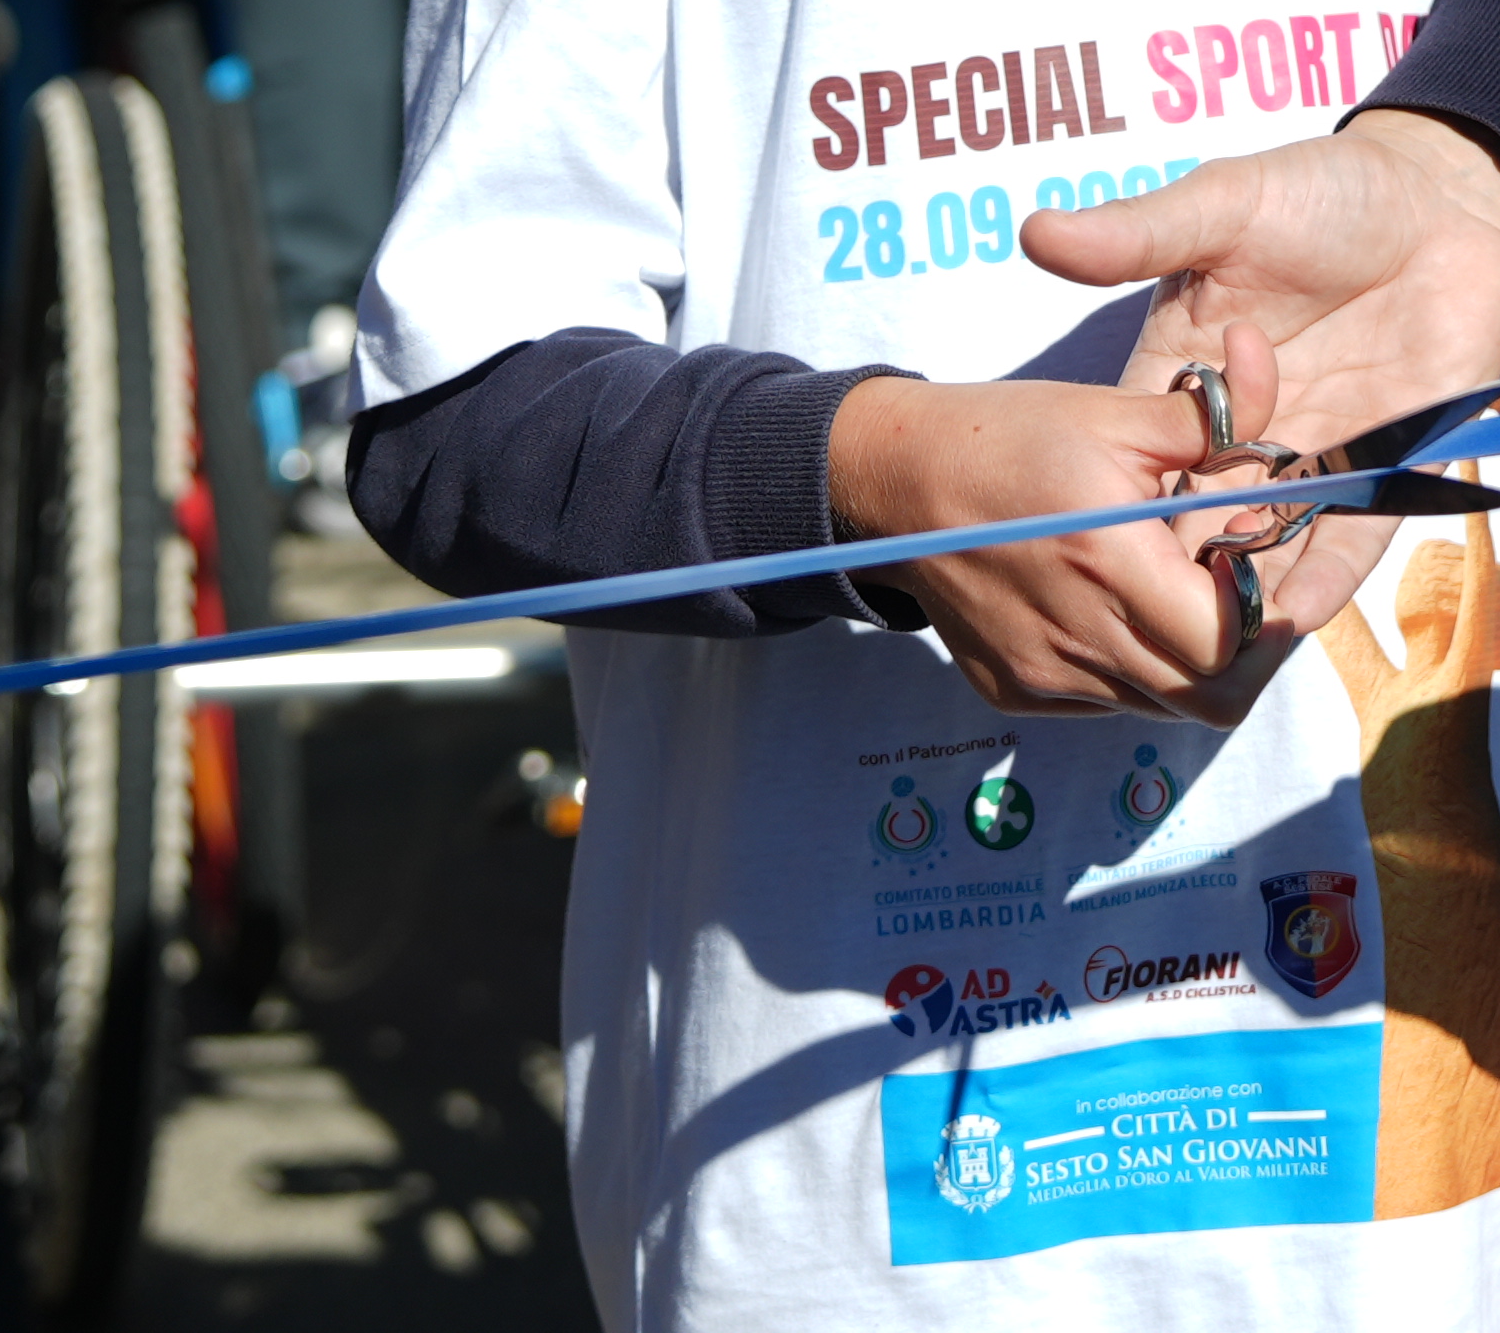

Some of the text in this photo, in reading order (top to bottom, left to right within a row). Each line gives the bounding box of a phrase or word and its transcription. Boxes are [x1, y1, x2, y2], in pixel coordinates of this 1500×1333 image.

[810, 40, 1127, 171] SPECIAL
[1146, 12, 1361, 124] SPORT
[859, 731, 1022, 766] con il Patrocinio di:
[1068, 848, 1235, 885] COMITATO TERRITORIALE
[875, 877, 1045, 906] COMITATO REGIONALE
[1070, 873, 1238, 913] MILANO MONZA LECCO
[876, 901, 1046, 937] LOMBARDIA
[961, 967, 1010, 1001] AD
[1103, 952, 1241, 997] FIORANI
[1185, 983, 1257, 1000] CICLISTICA
[950, 993, 1071, 1036] ASTRA
[1075, 1083, 1262, 1114] in collaborazione con
[1111, 1104, 1238, 1139] CITTÀ DI
[1026, 1135, 1329, 1187] SESTO SAN GIOVANNI
[1027, 1180, 1110, 1205] MEDAGLIA
[1174, 1168, 1194, 1183] AL
[1198, 1165, 1252, 1182] VALOR
[1256, 1161, 1329, 1178] MILITARE
